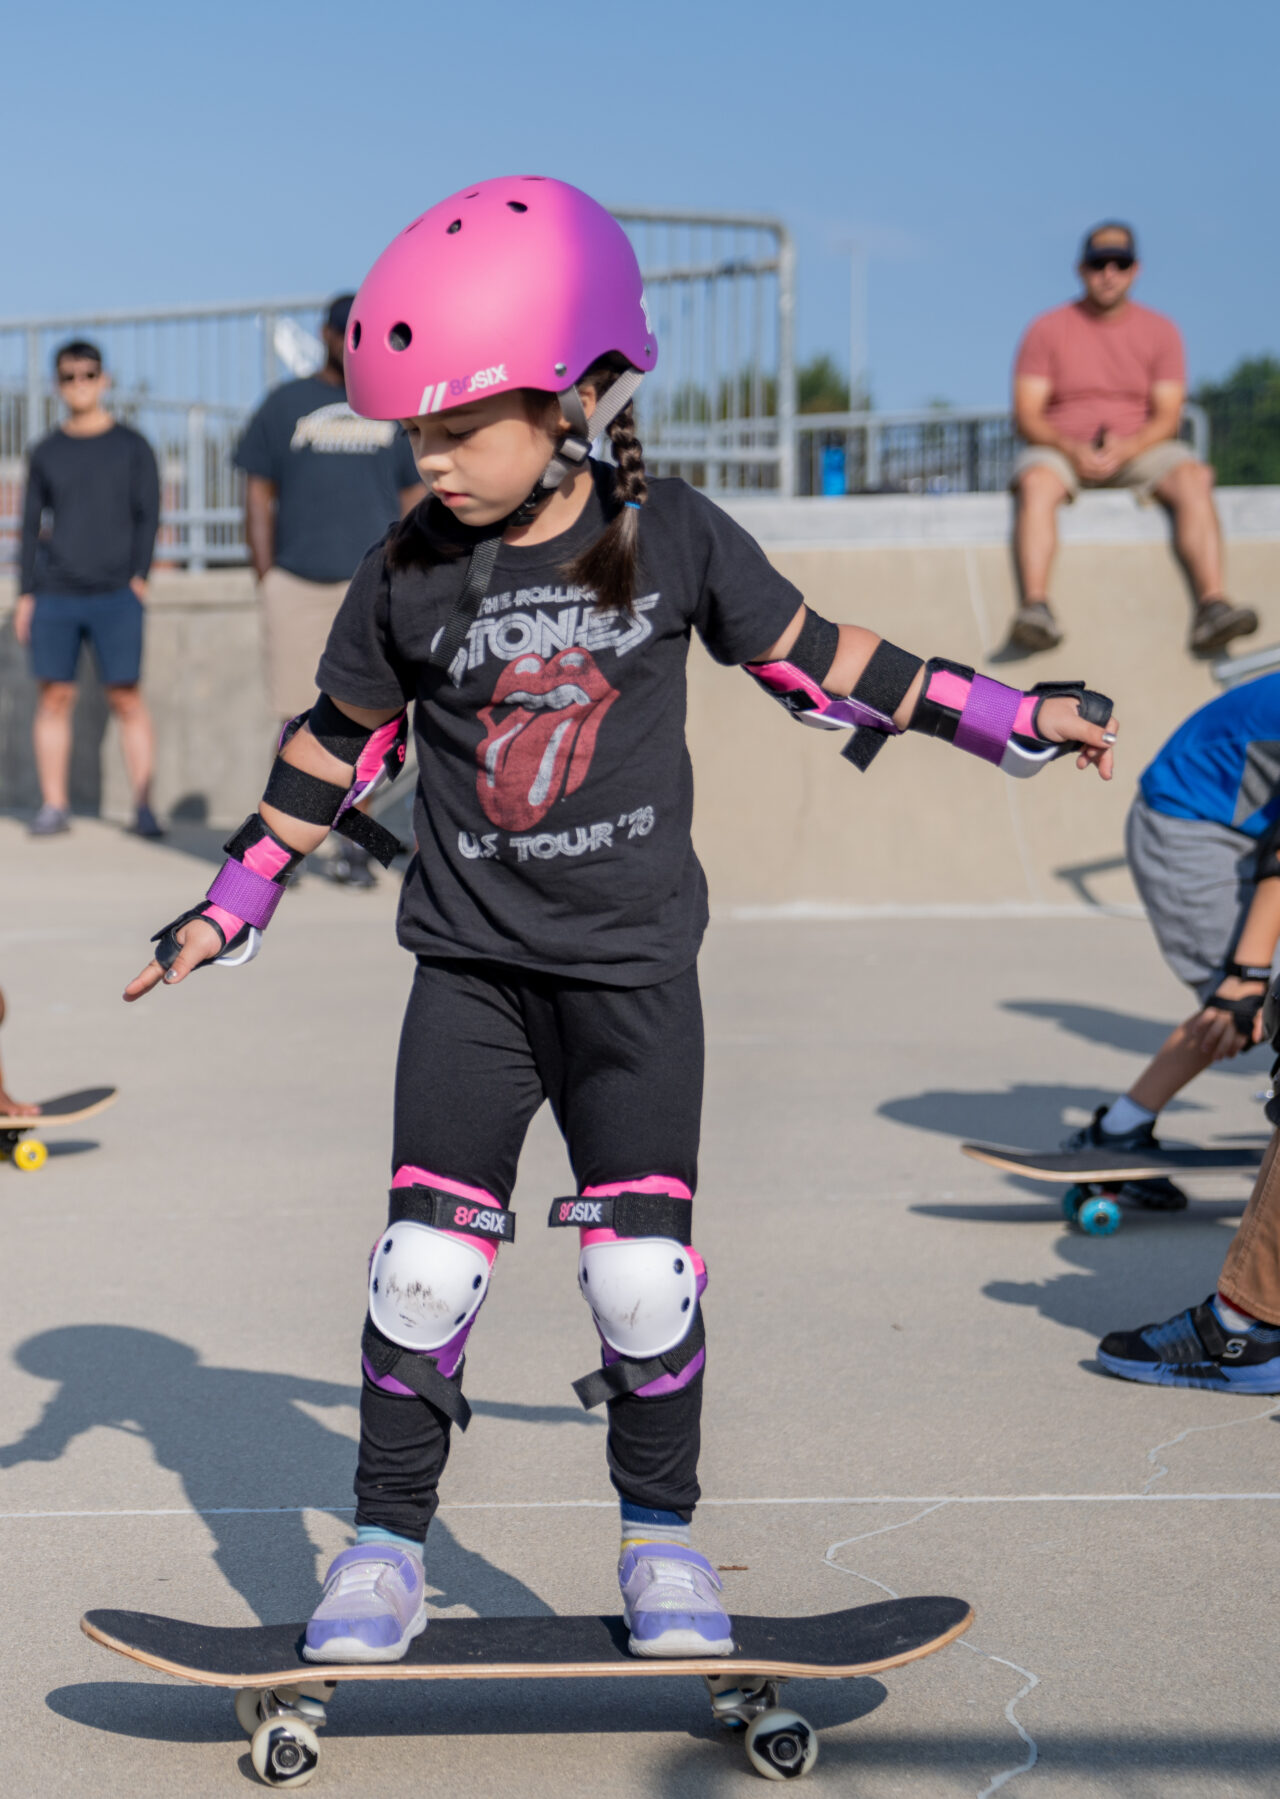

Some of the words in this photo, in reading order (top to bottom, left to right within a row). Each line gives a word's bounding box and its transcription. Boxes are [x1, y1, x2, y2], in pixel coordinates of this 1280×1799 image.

[449, 363, 508, 395] 80SIX
[515, 583, 600, 606] ROLLIN
[509, 822, 614, 862] TOUR
[454, 1206, 505, 1234] 80SIX
[559, 1202, 602, 1222] 80SIX
